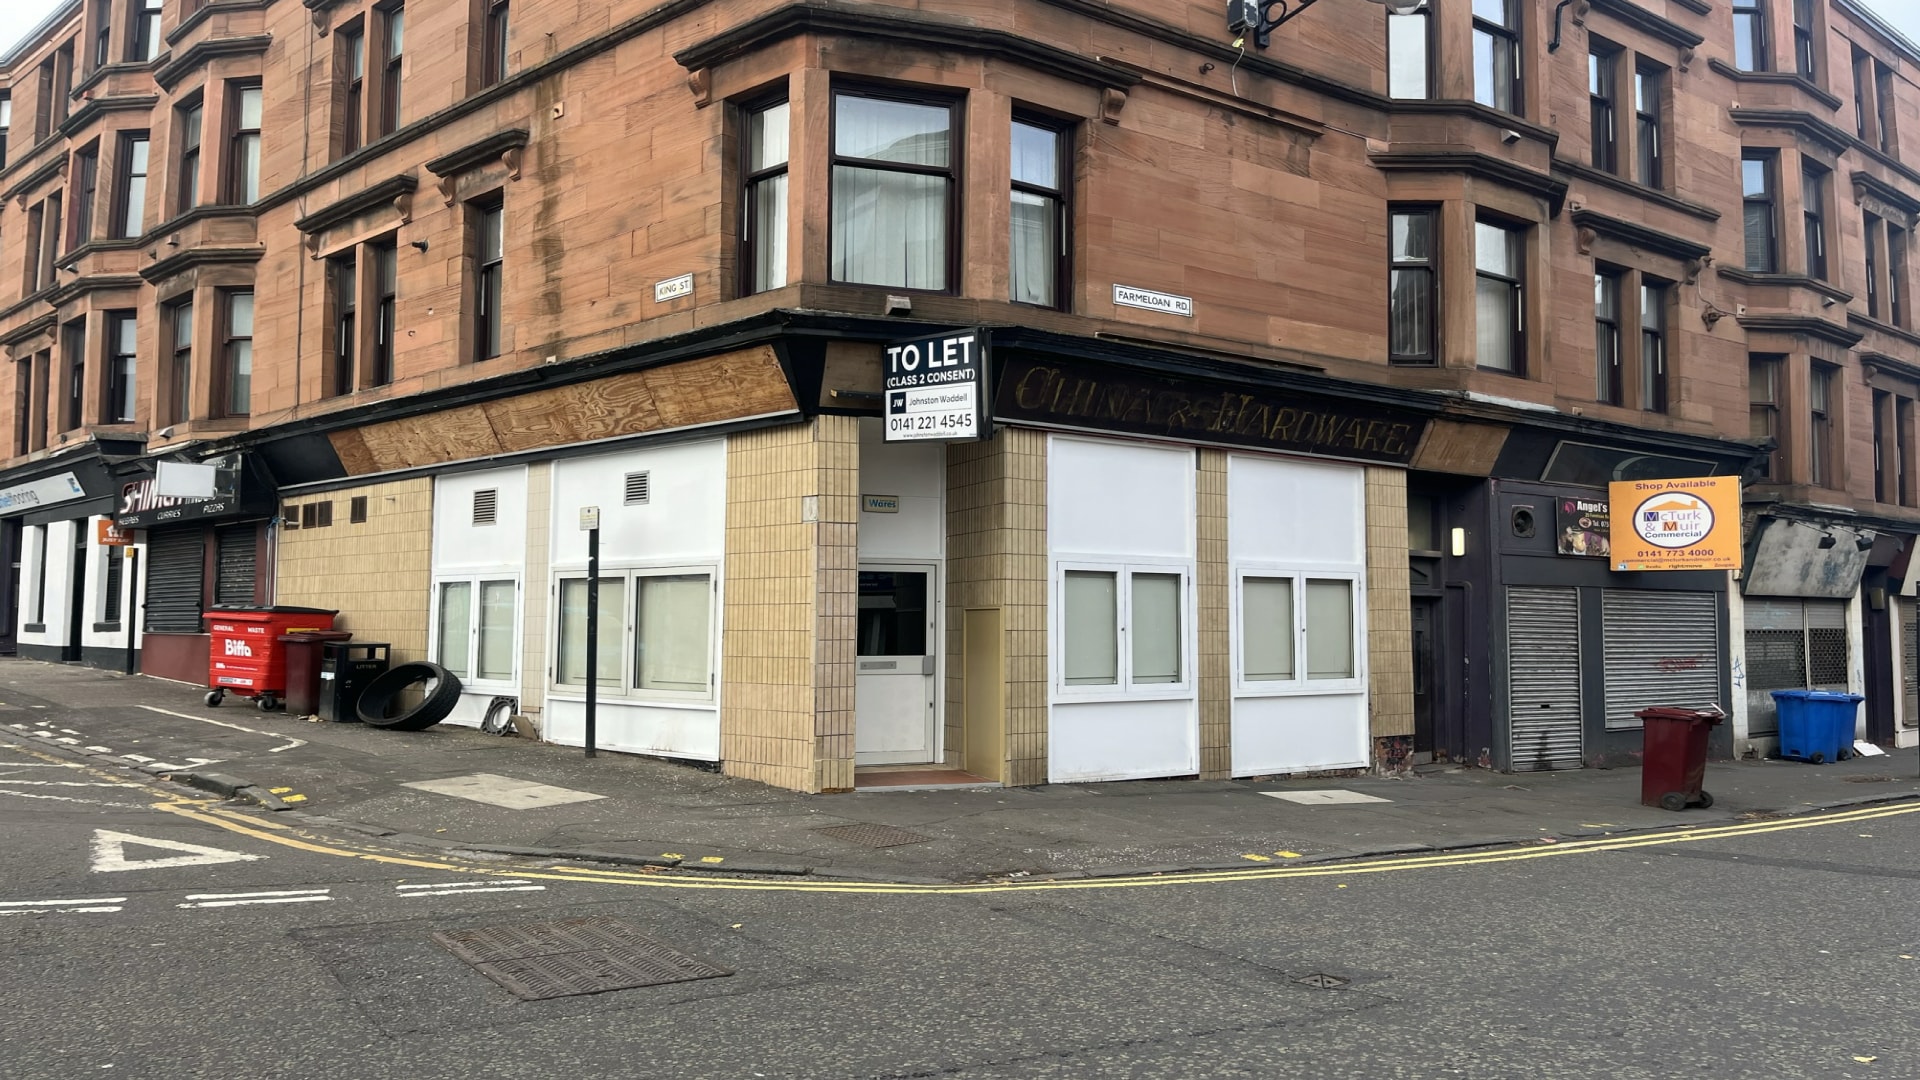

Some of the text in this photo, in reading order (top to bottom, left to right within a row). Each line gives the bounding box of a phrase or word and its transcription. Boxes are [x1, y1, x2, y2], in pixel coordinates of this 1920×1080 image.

[660, 280, 689, 295] KING ST
[1118, 291, 1171, 307] FARMELOAN
[887, 336, 975, 373] TO LET
[886, 368, 975, 388] (CLASS 2 CONSENT)
[909, 392, 968, 407] Johnston Waddell
[890, 413, 972, 431] 0141 221 4545
[1635, 479, 1716, 490] Shop Available
[157, 509, 182, 520] CURRIES
[203, 502, 225, 514] PIZZAS
[1577, 500, 1608, 513] Angel's
[1644, 510, 1701, 522] McTurk
[1645, 521, 1700, 532] & Muir
[1645, 531, 1702, 539] Commercial
[1637, 549, 1714, 558] 0141 773 4000
[224, 638, 252, 657] Biffa
